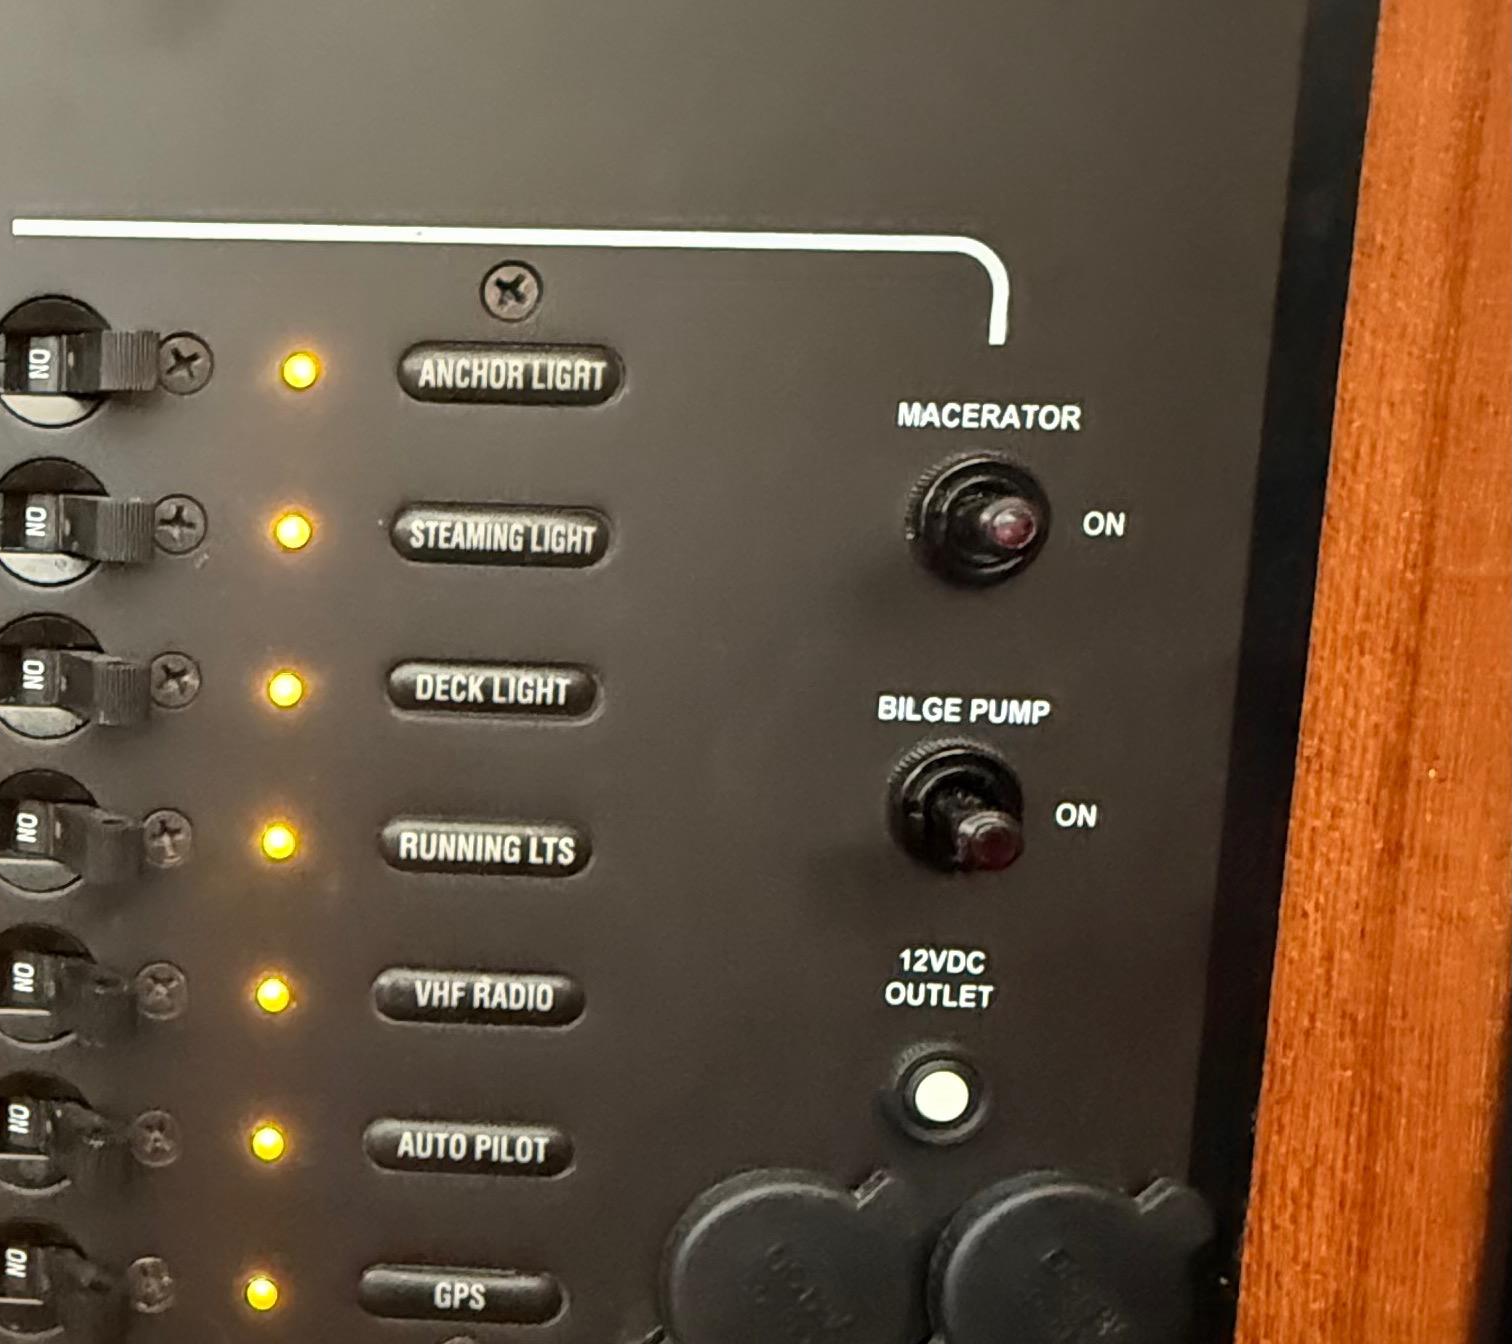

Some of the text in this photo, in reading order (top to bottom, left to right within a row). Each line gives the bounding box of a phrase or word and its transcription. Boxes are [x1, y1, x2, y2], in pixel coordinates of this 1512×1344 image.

[28, 348, 51, 379] ON
[419, 361, 607, 391] ANCHOR LIGHT
[897, 401, 1082, 431] MACERATOR
[25, 506, 47, 537] ON
[1082, 510, 1126, 537] ON
[410, 521, 596, 554] STEAMING LIGHT
[22, 659, 45, 690] ON
[415, 675, 571, 705] DECK LIGHT
[877, 695, 1051, 725] BILGE PUMP
[16, 812, 38, 843] ON
[1055, 802, 1097, 828] ON
[399, 831, 575, 866] RUNNING LTS
[899, 948, 986, 975] 12VDC
[12, 962, 35, 993] ON
[414, 980, 553, 1010] VHF RADIO
[884, 981, 994, 1008] OUTLET
[8, 1104, 30, 1135] ON
[397, 1132, 549, 1164] AUTO PILOT
[5, 1248, 28, 1278] ON
[433, 1283, 486, 1310] GPS
